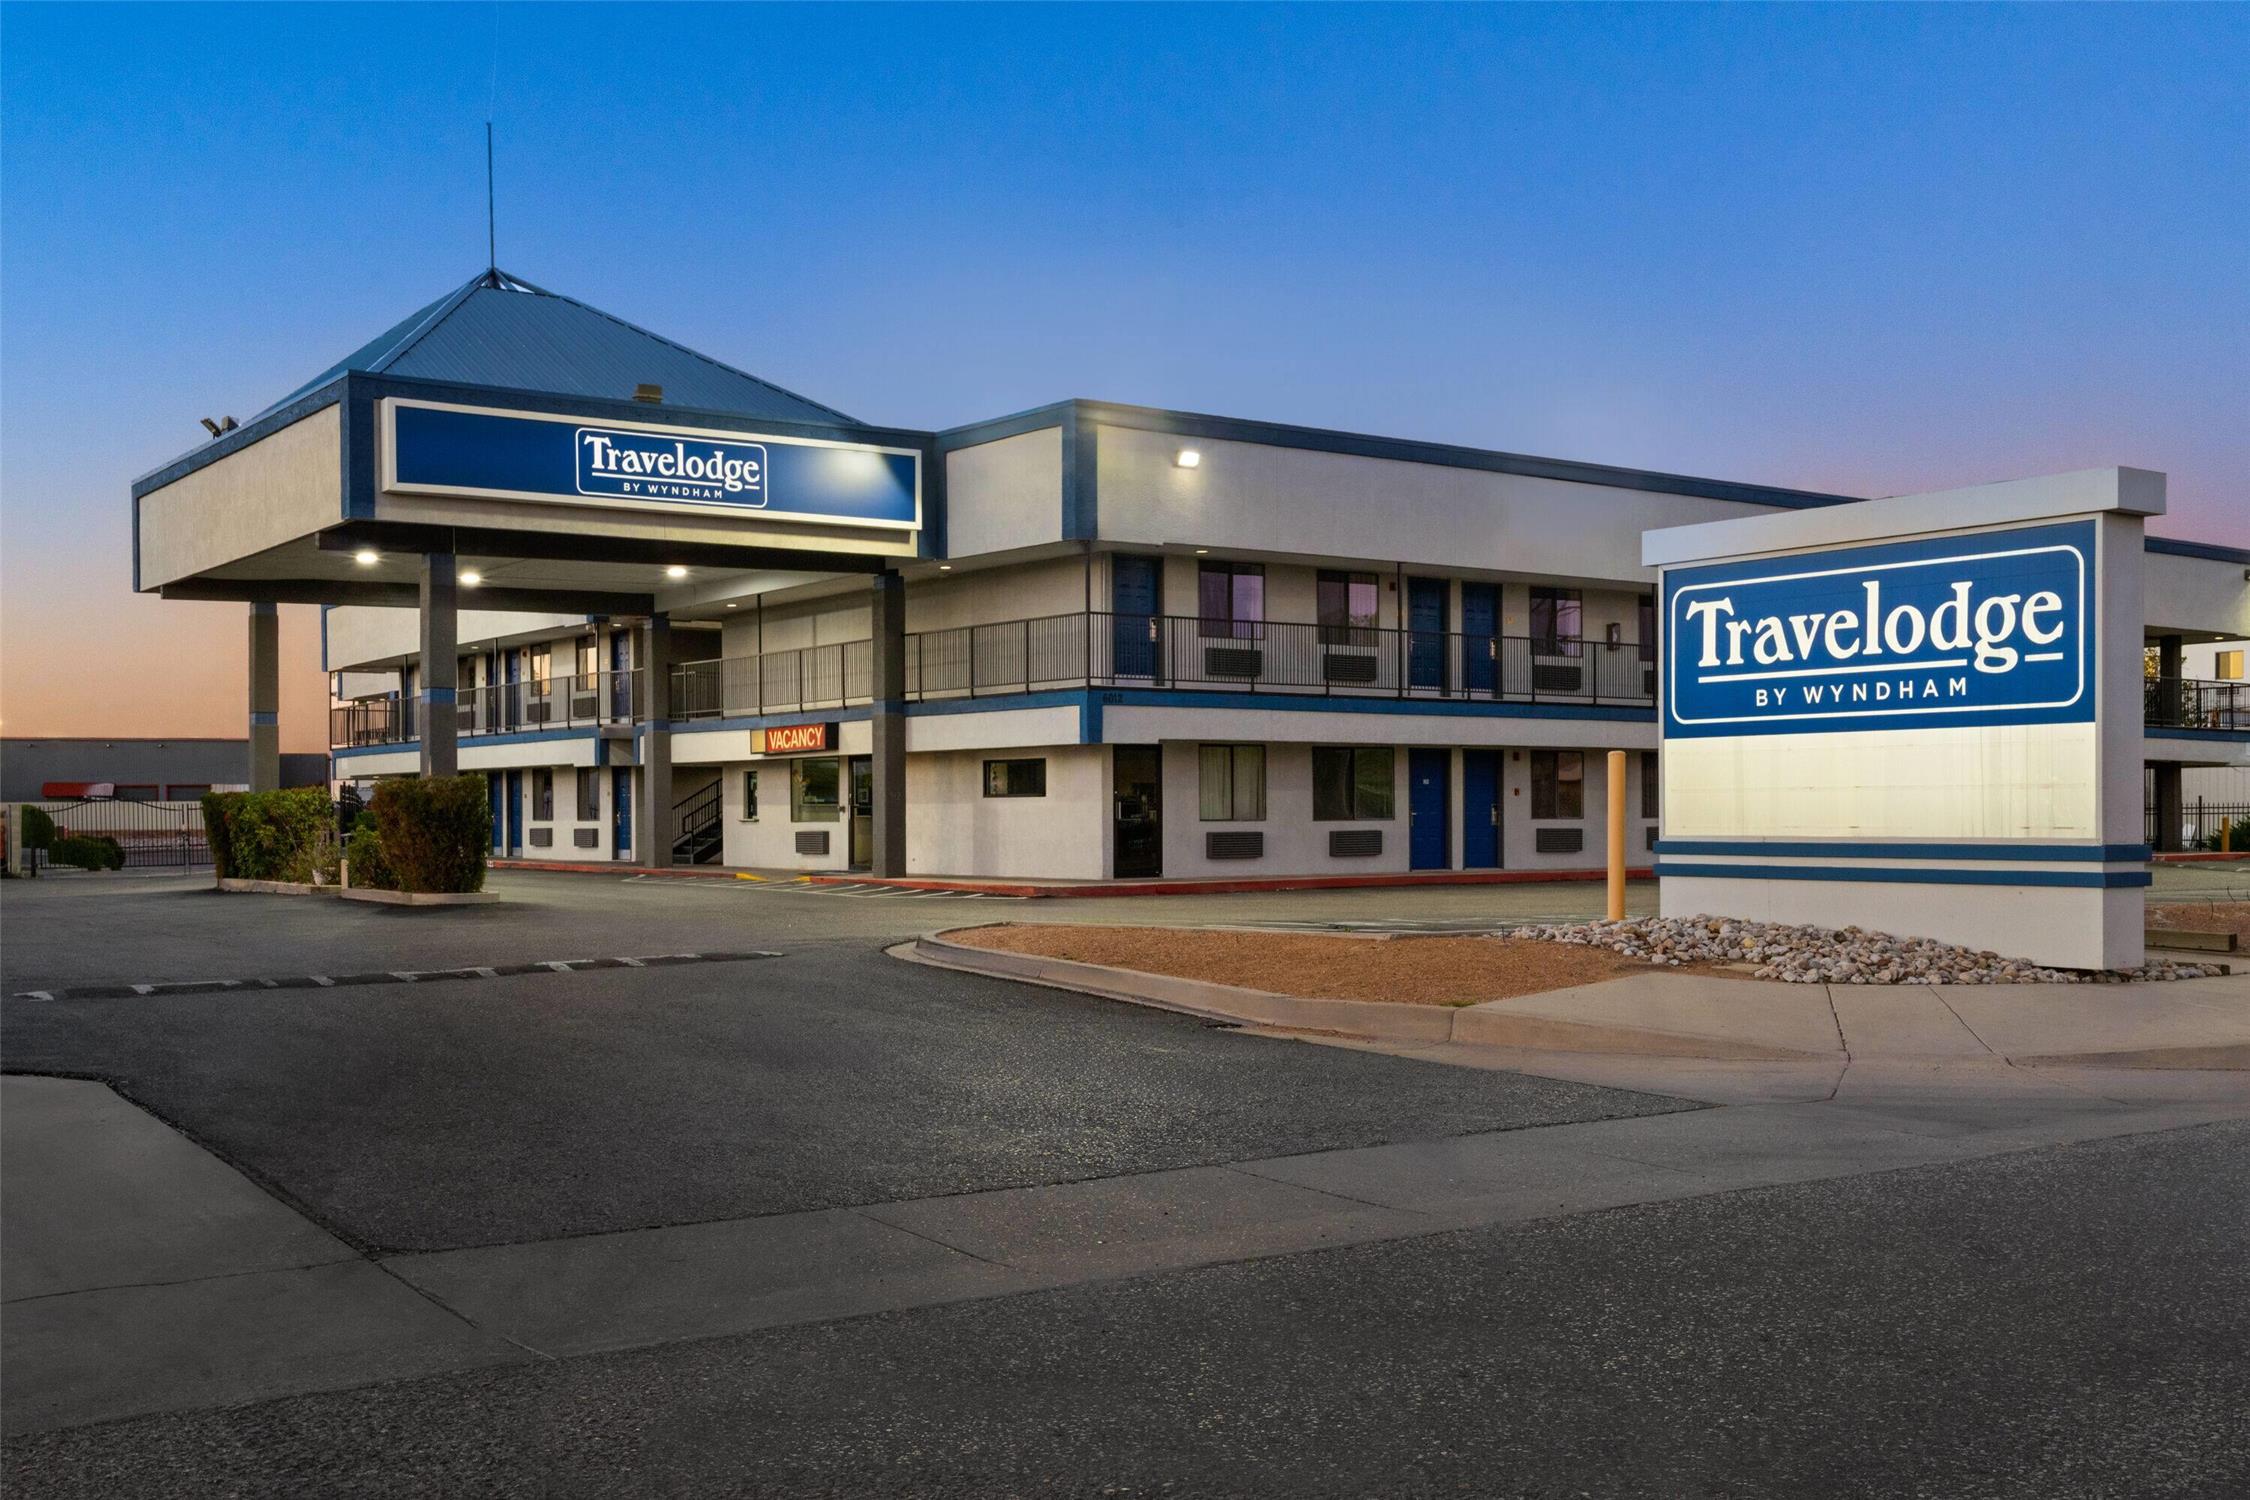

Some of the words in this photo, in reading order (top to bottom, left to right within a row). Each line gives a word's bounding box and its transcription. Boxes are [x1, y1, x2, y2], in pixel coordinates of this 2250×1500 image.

[584, 434, 760, 492] Travelodge
[623, 482, 640, 492] BY
[648, 484, 723, 499] WYNDHAM
[1686, 580, 2064, 674] Travelodge
[1756, 687, 1787, 707] BY
[1804, 677, 1967, 705] WYNDHAM
[768, 727, 823, 750] VACANCY
